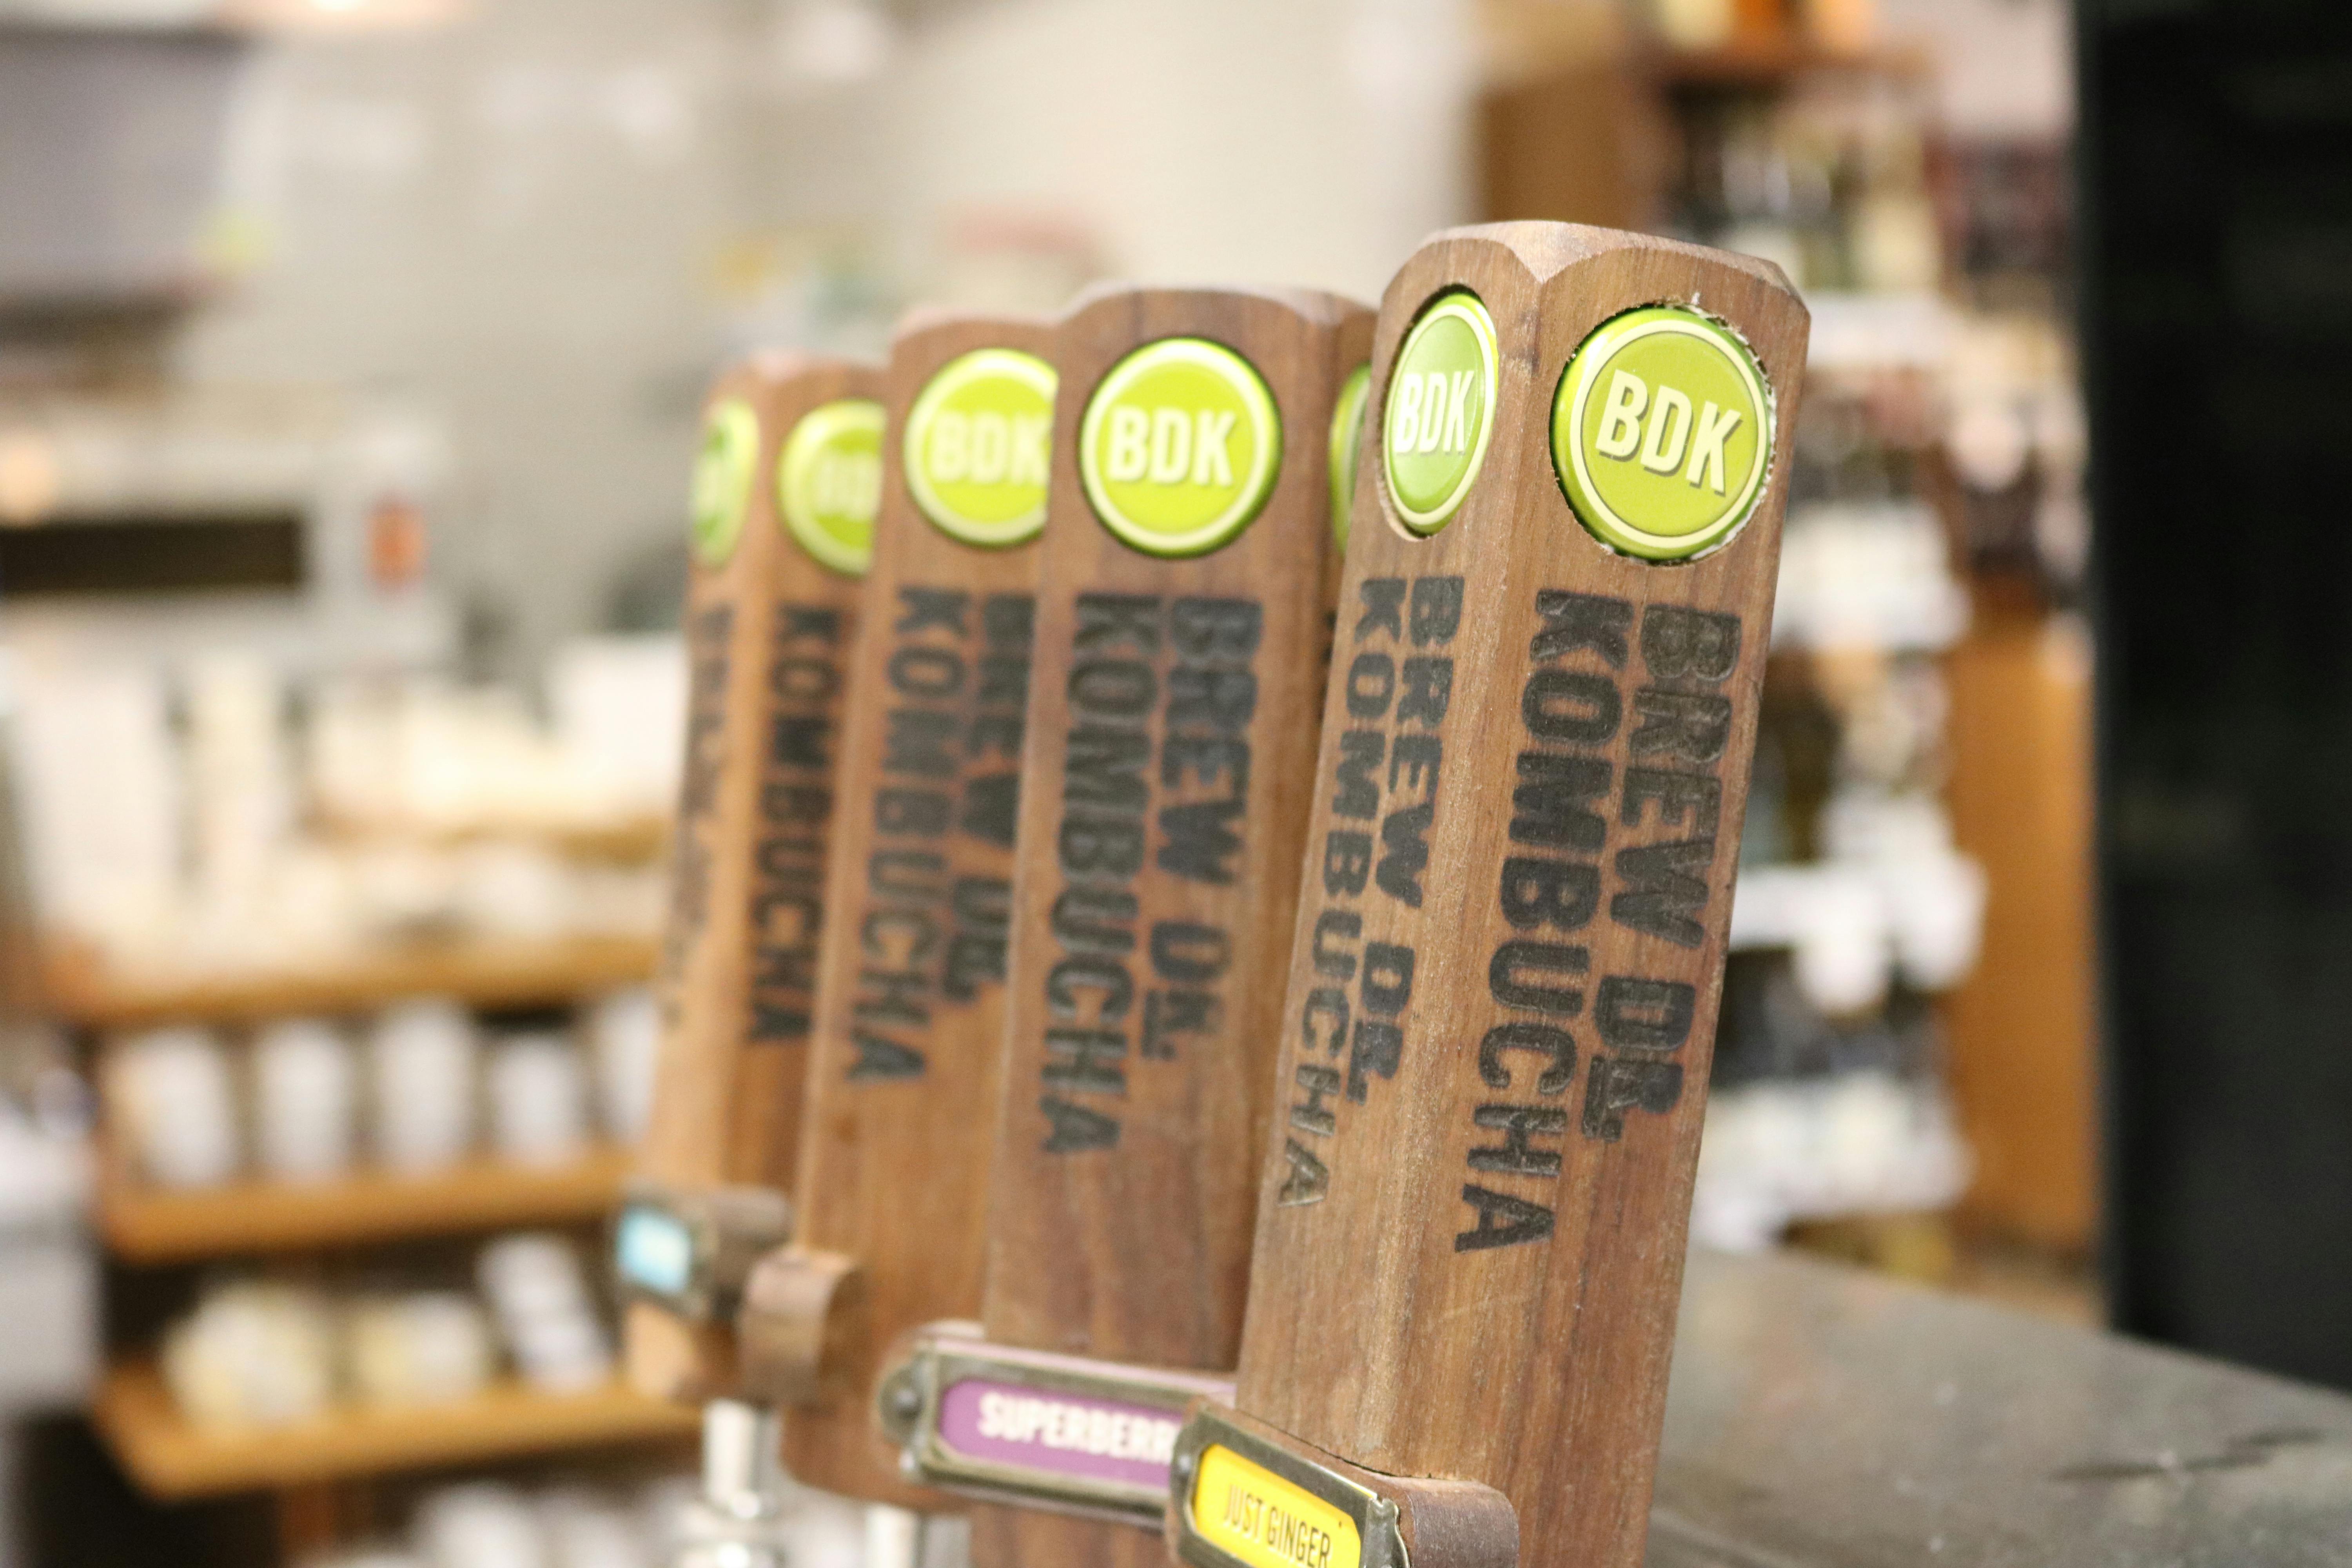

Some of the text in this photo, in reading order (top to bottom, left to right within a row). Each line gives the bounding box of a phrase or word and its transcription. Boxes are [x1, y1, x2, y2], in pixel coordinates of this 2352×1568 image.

[931, 410, 1051, 485] BDK
[1108, 405, 1236, 487] BDK
[1394, 369, 1475, 455] BDK
[1595, 369, 1743, 497] BDK
[846, 586, 972, 1085] KOMBUCHA
[1040, 592, 1163, 1155] KOMBUCHA
[1156, 596, 1264, 887] BREW
[1376, 575, 1465, 908] BREW
[1608, 604, 1741, 949] BREW
[1277, 576, 1407, 1209] KOMBUCHA
[1455, 589, 1634, 1254] KOMBUCHA
[977, 1391, 1180, 1466] SUPERBERR
[1223, 1484, 1331, 1568] JUST GINGER
